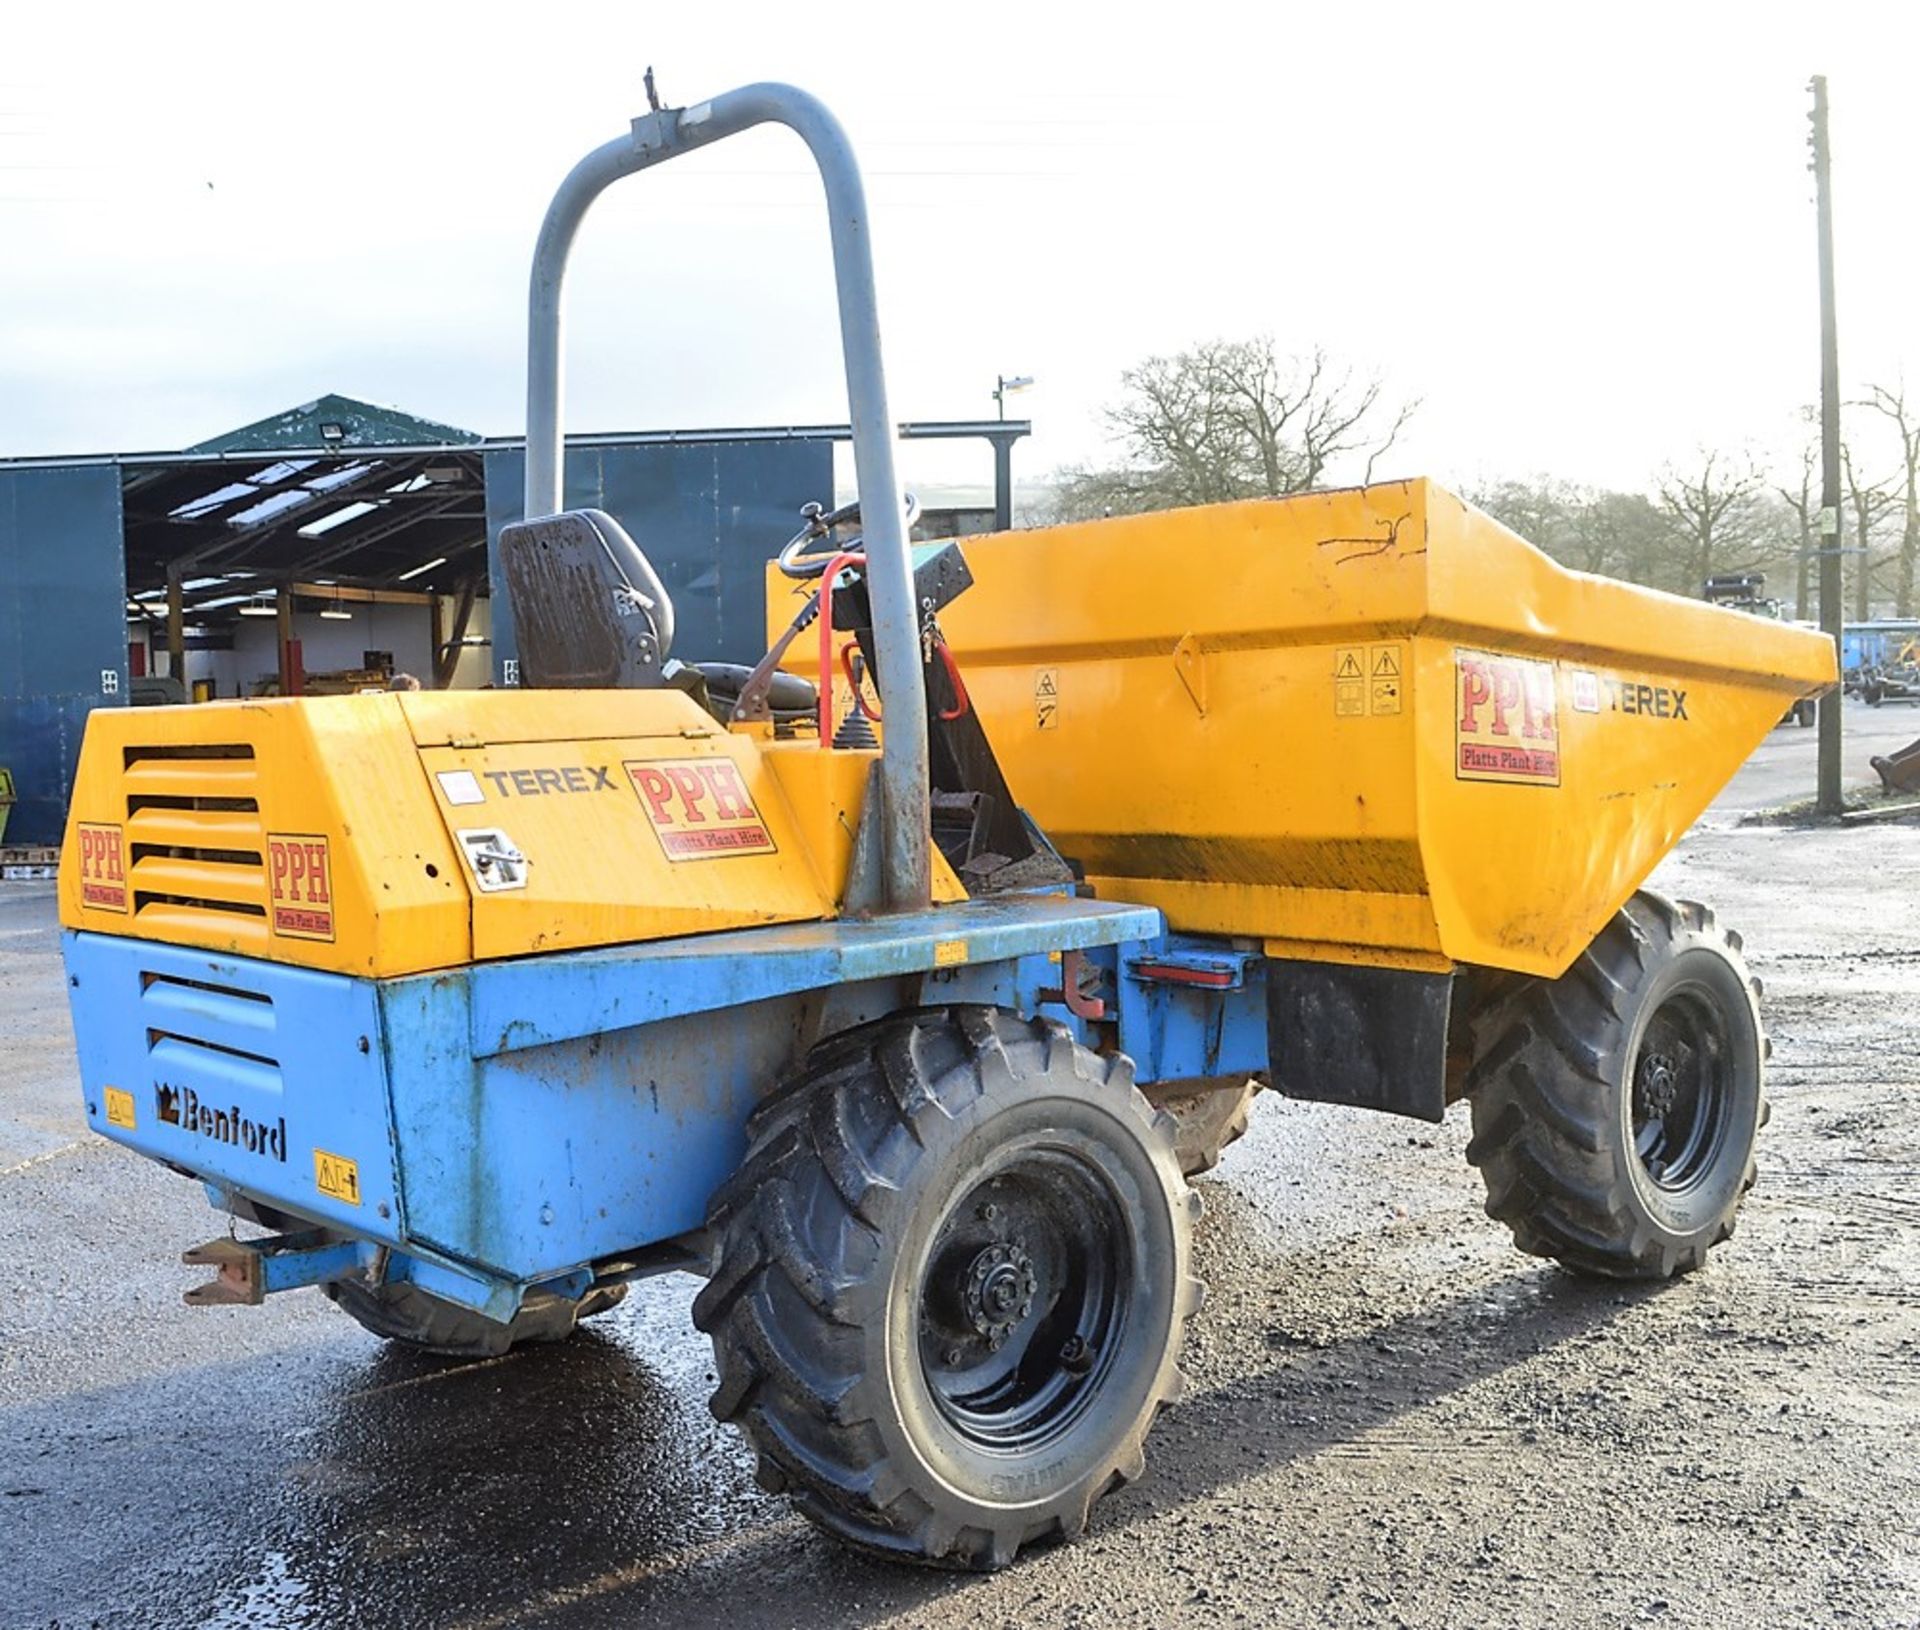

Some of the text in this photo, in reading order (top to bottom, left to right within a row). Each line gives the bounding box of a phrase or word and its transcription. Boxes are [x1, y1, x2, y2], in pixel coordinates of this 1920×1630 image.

[1460, 659, 1555, 739] PPH
[1603, 679, 1689, 721] TEREX
[483, 766, 619, 797] TEREX
[1464, 750, 1499, 767] Platts
[1501, 752, 1530, 770] Plant
[631, 765, 756, 824] PPH
[80, 829, 124, 881] PPH
[705, 833, 737, 847] Plant
[737, 830, 766, 845] Hire
[270, 842, 329, 903] PPH
[182, 1086, 287, 1163] Benford
